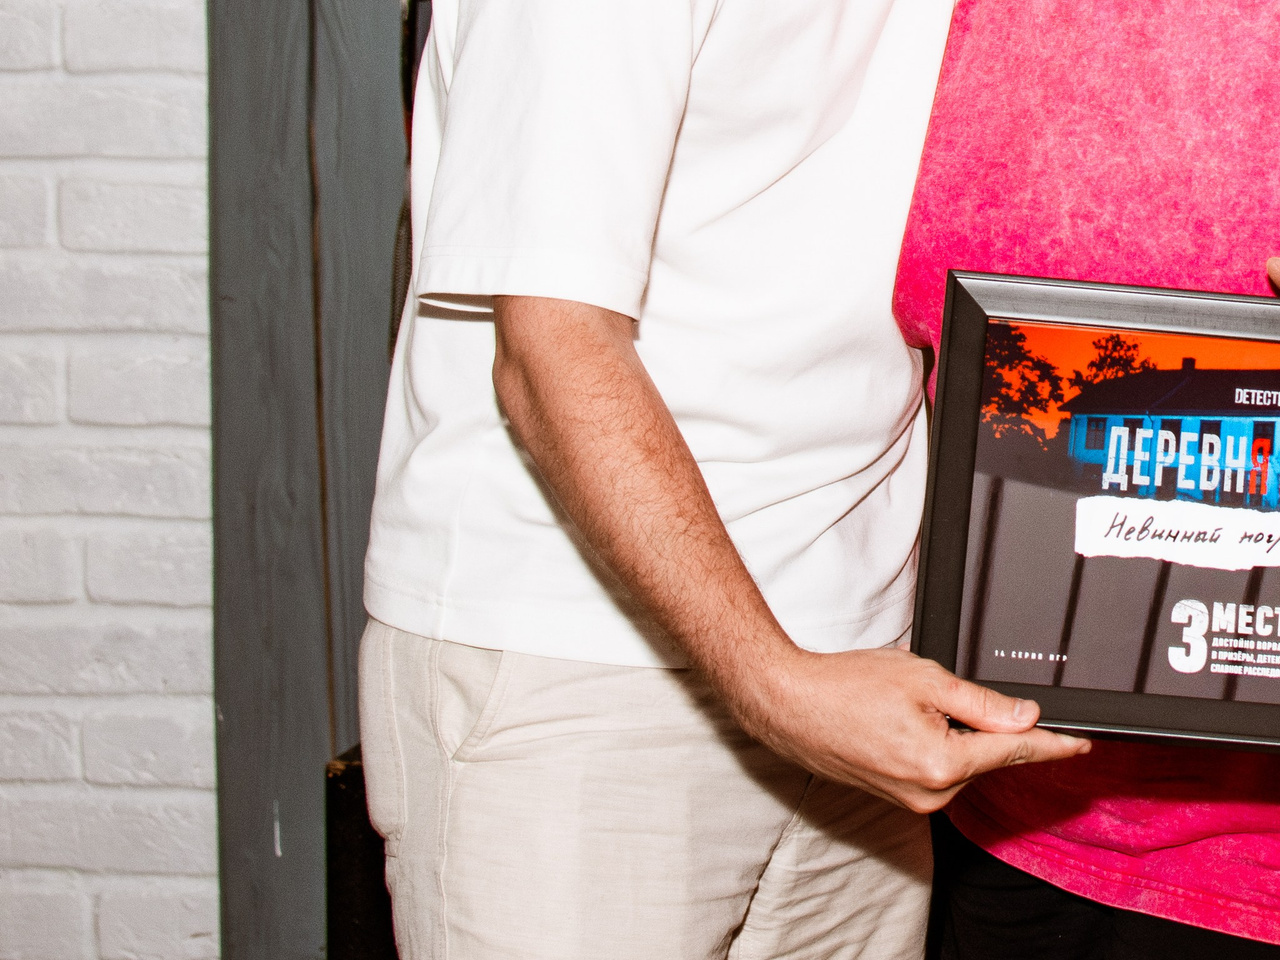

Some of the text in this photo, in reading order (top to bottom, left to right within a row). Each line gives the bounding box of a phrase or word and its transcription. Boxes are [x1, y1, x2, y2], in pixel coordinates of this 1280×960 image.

[1104, 512, 1224, 544] Невинный
[1168, 598, 1209, 674] 3
[1211, 637, 1255, 650] ДОСТОЙНО
[1211, 650, 1218, 660] В
